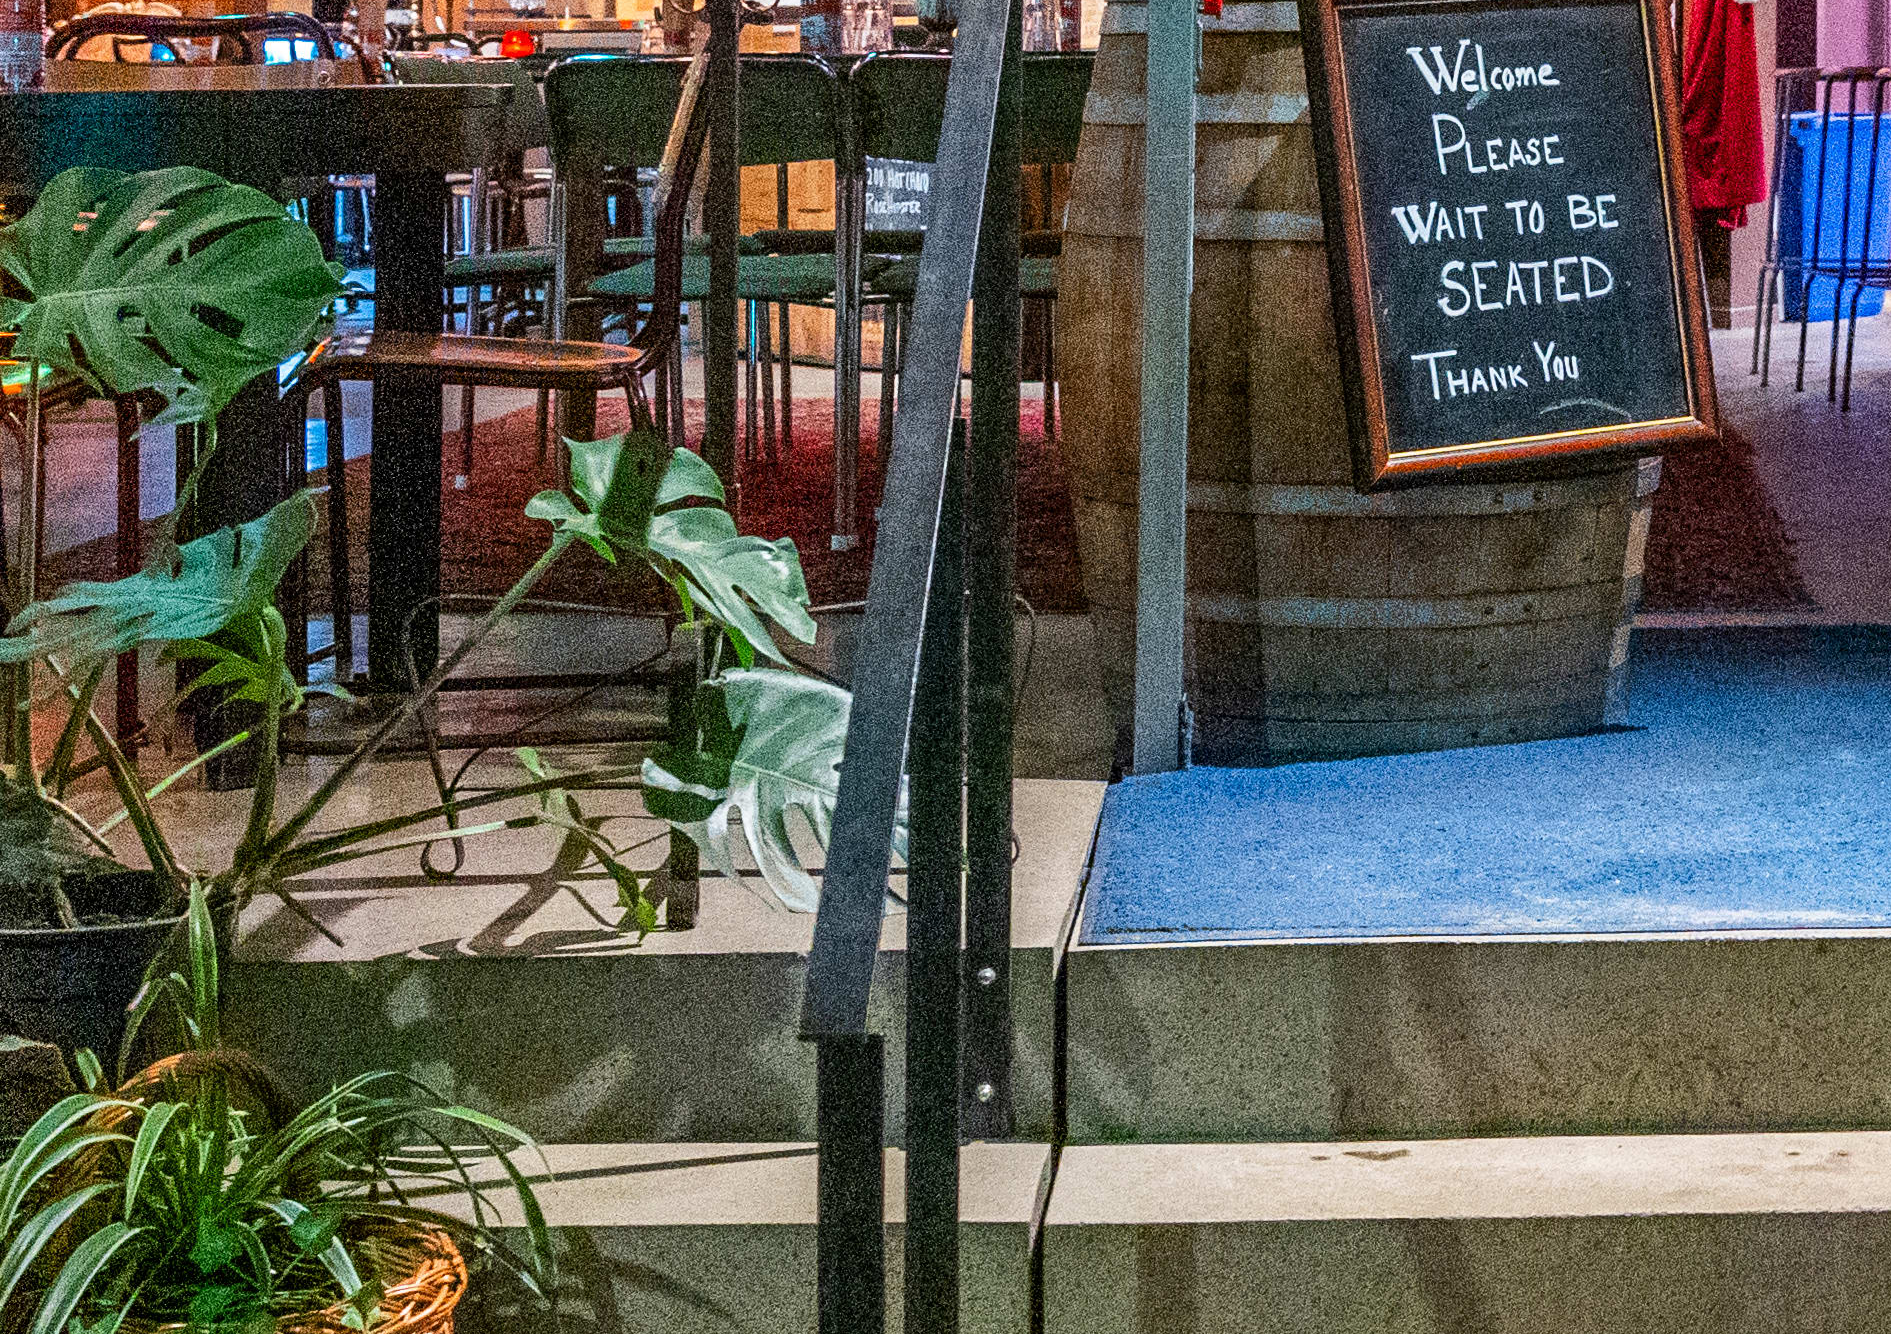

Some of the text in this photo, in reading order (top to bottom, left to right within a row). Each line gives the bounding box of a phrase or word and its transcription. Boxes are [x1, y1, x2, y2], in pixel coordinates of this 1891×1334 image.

[1406, 39, 1560, 95] Welcome
[1432, 113, 1564, 175] PLEASE
[1391, 193, 1618, 244] WAIT TO BE
[1437, 256, 1614, 317] SEATED
[1411, 349, 1529, 400] THANK
